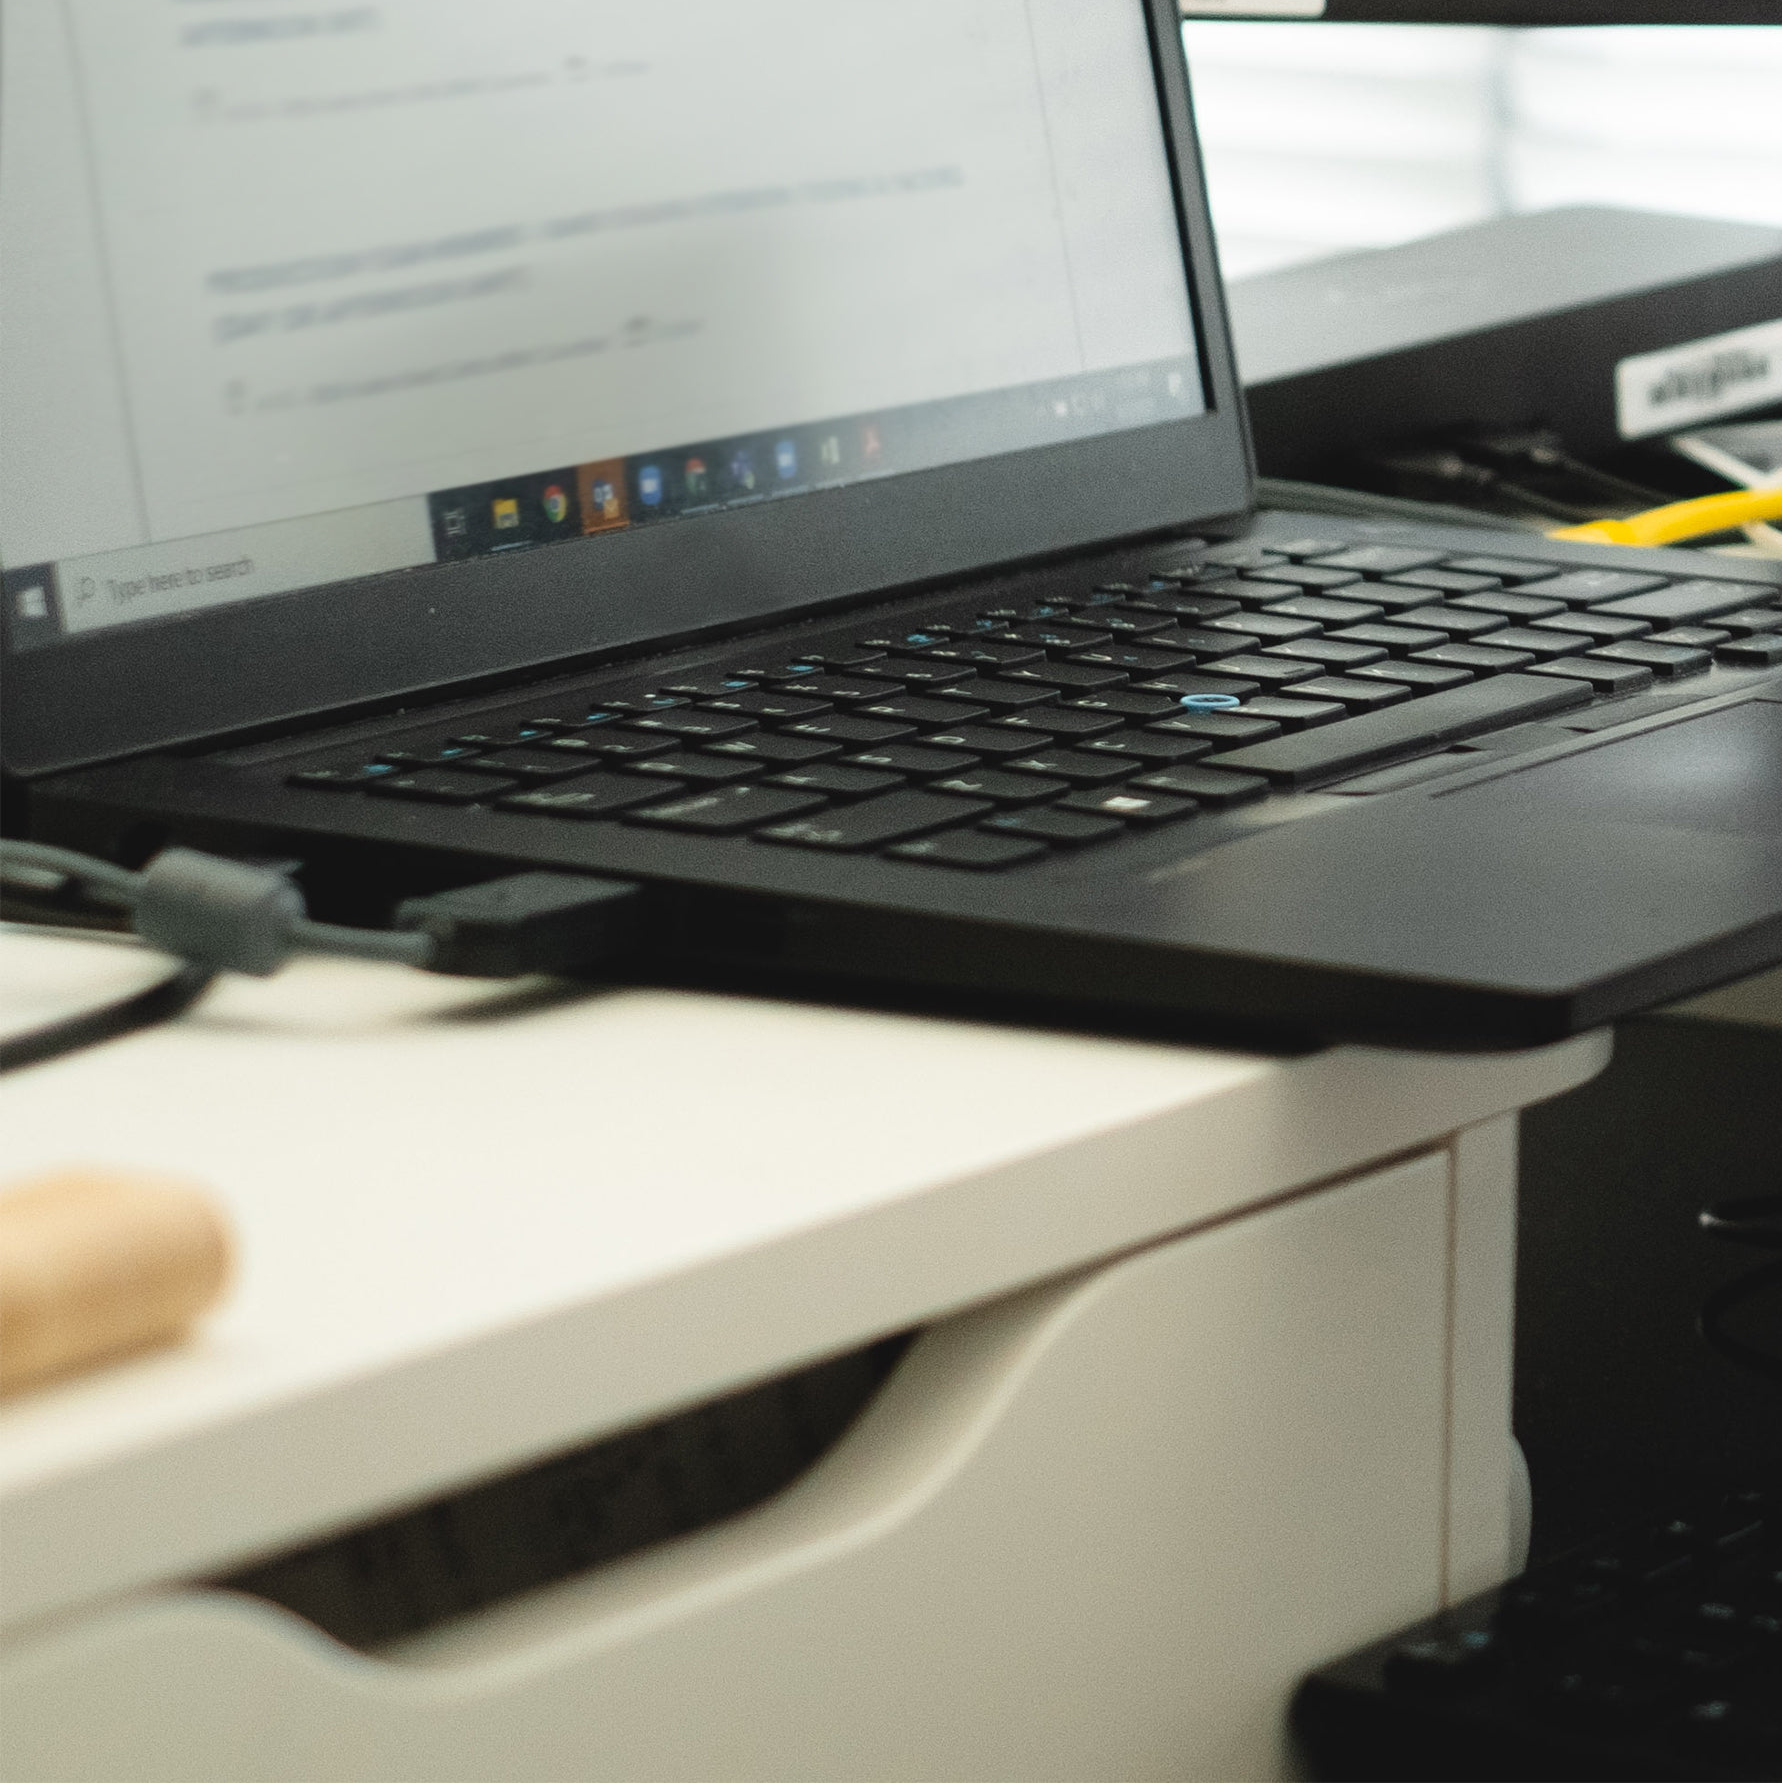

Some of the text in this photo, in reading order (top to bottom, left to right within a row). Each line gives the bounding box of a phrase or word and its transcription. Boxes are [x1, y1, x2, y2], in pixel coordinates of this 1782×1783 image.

[106, 557, 253, 606] Type here to search
